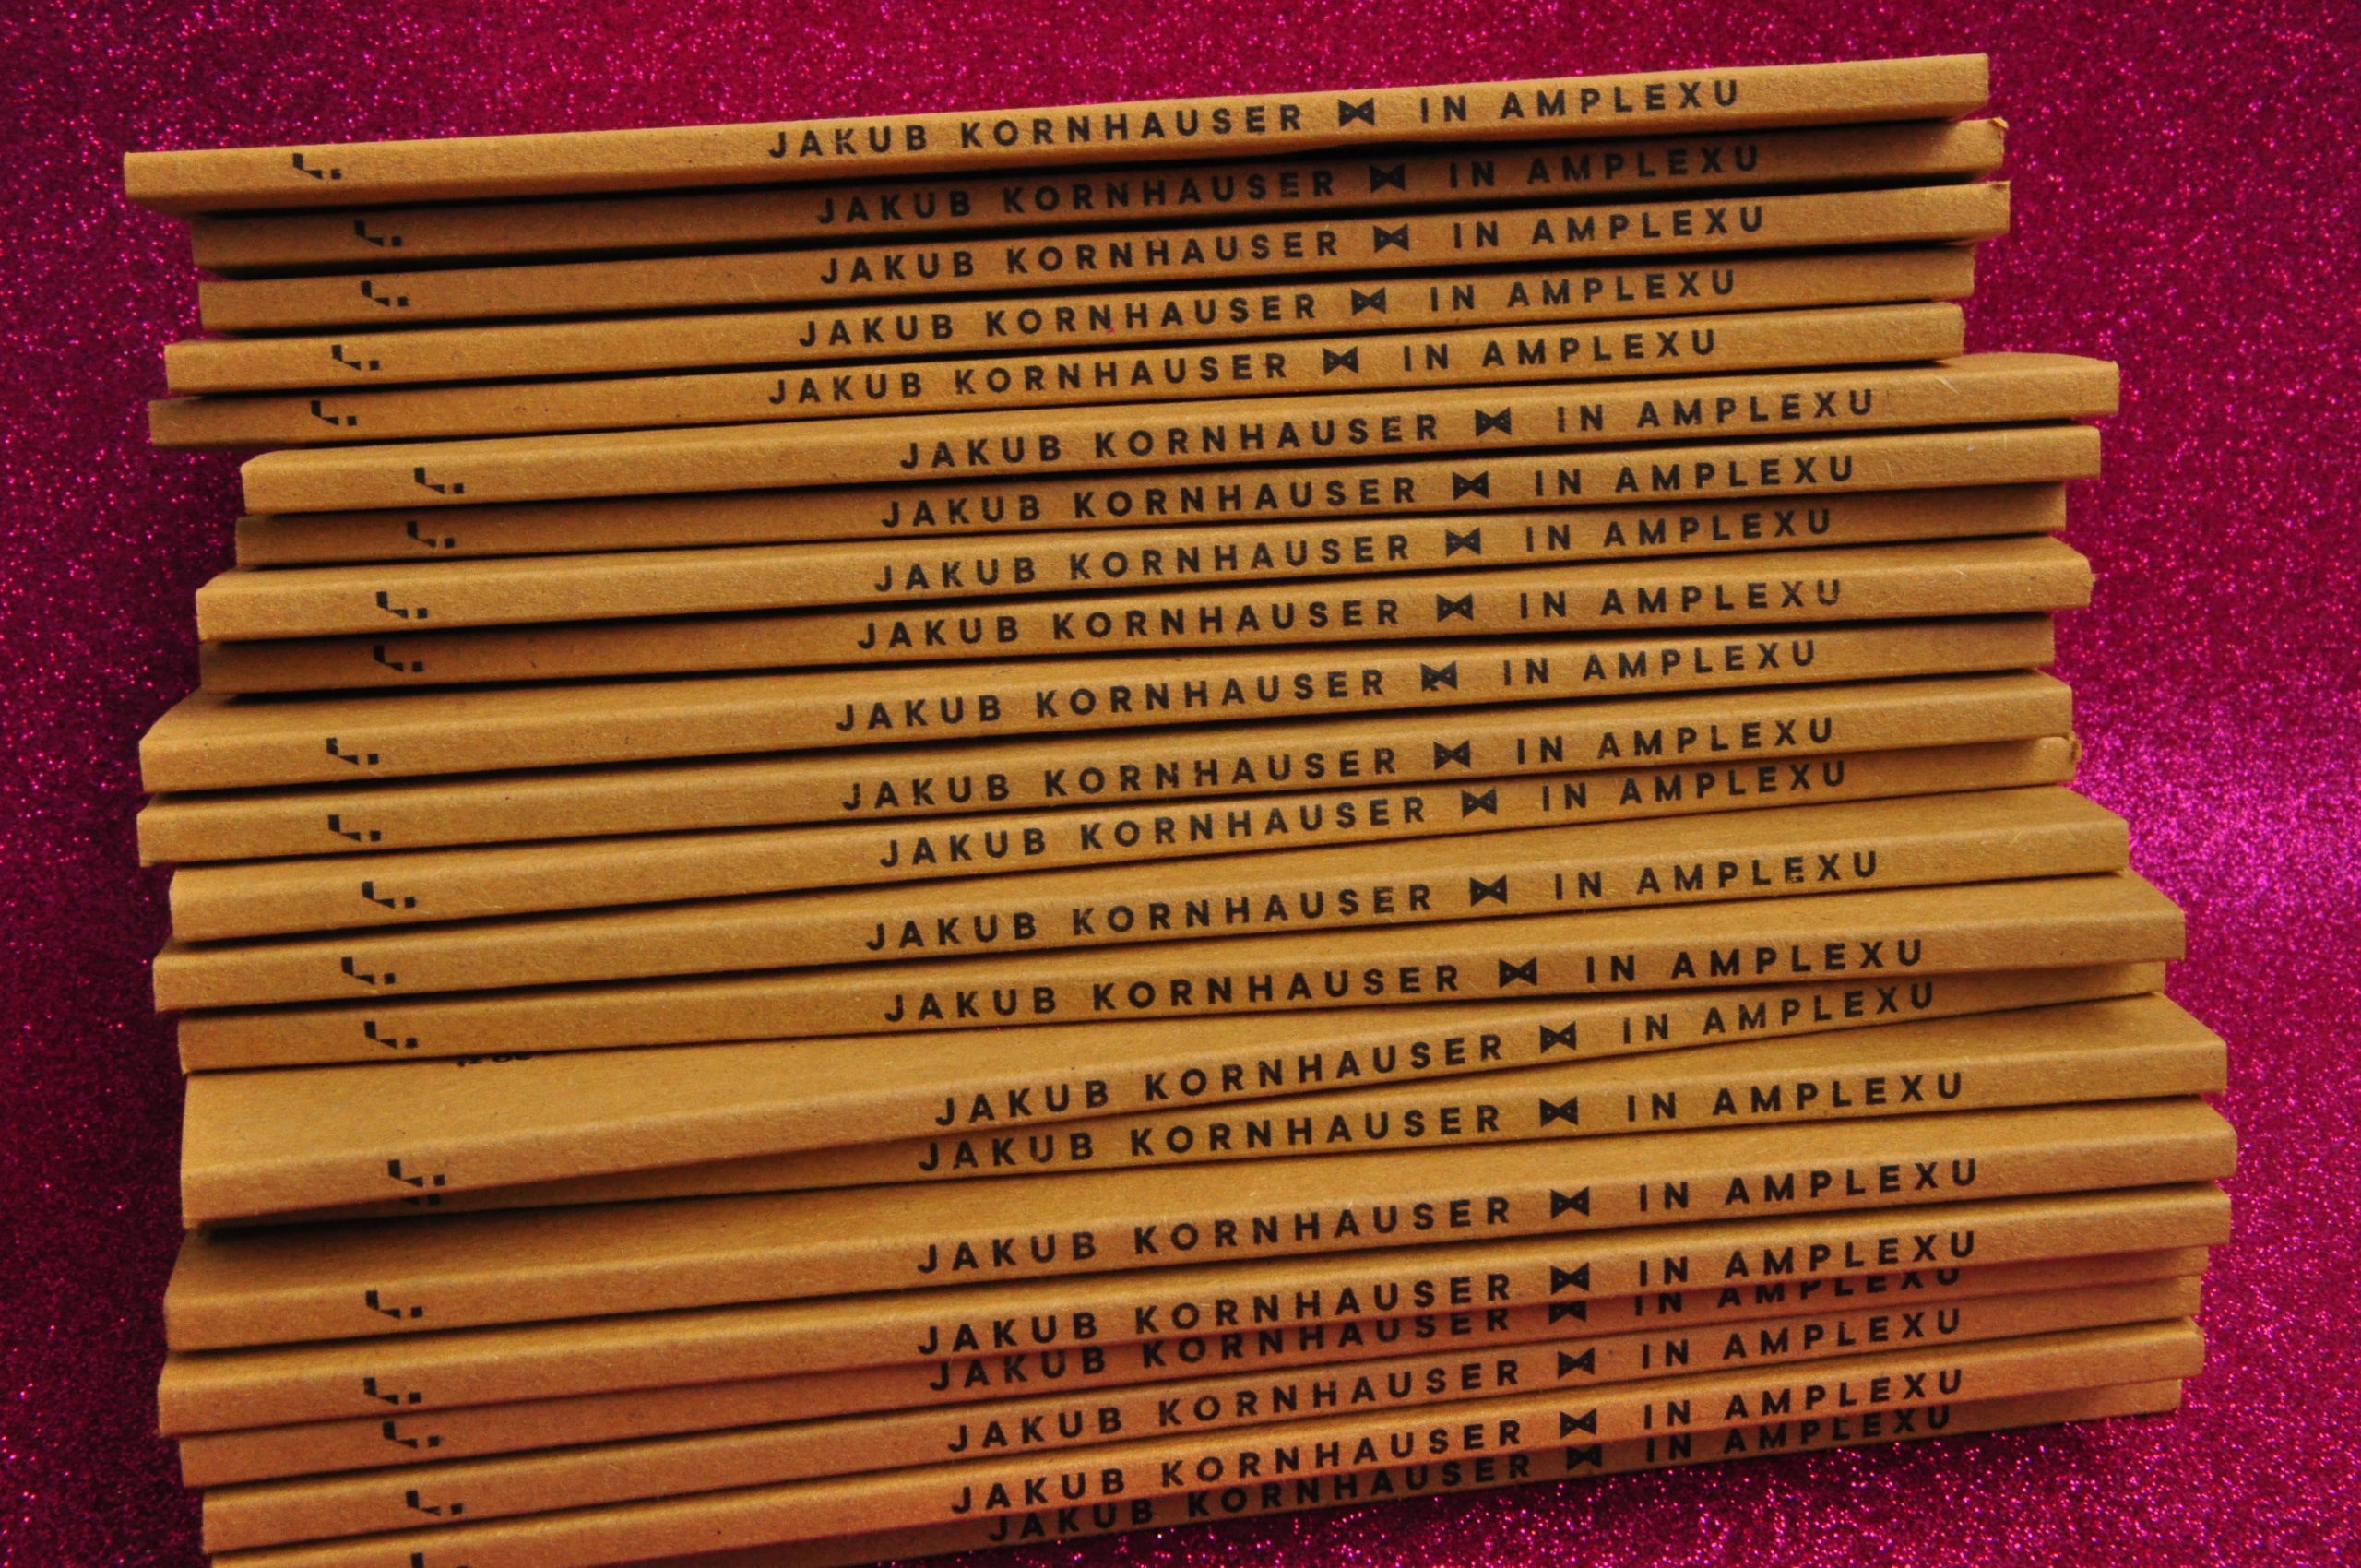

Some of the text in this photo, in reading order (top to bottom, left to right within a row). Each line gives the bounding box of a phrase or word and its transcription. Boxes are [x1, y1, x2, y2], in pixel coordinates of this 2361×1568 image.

[768, 79, 1738, 159] JAKUB KORNHAUSER IN AMPLEXU
[817, 143, 1759, 225] JAKUB KORNHAUSER IN AMPLEXU
[820, 206, 1762, 285] JAKUB KORNHAUSER IN AMPLEXU
[798, 269, 1734, 348] JAKUB KORNHAUSER IN AMPLEXU
[768, 328, 1714, 405] JAKUB KORNHAUSER IN AMPLEXU
[899, 388, 1872, 469] JAKUB KORNHAUSER IN AMPLEXU
[881, 455, 1853, 529] JAKUB KORNHAUSER IN AMPLEXU
[874, 507, 1830, 592] JAKUB KORNHAUSER IN AMPLEXU
[857, 579, 1841, 650] JAKUB KORNHAUSER IN AMPLEXU
[836, 639, 1814, 731] JAKUB KORNHAUSER IN AMPLEXU
[842, 717, 1833, 811] JAKUB KORNHAUSER IN AMPLEXU
[879, 758, 1845, 868] JAKUB KORNHAUSER IN AMPLEXU
[865, 850, 1877, 951] JAKUB KORNHAUSER IN AMPLEXU
[884, 938, 1922, 1023] JAKUB KORNHAUSER IN AMPLEXU
[935, 980, 1933, 1126] JAKUB KORNHAUSER IN AMPLEXU
[919, 1072, 1962, 1172] JAKUB KORNHAUSER IN AMPLEXU
[917, 1158, 1976, 1274] JAKUB KORNHAUSER IN AMPLEXU
[917, 1230, 1975, 1355] JAKUB KORNHAUSER IN AMPLEXU
[929, 1345, 1106, 1392] JAKUB
[1141, 1307, 1510, 1369] KORNHAUSER
[1633, 1291, 1684, 1317] IN
[947, 1307, 1960, 1453] JAKUB KORNHAUSER IN AMPLEXU
[951, 1368, 1962, 1514] JAKUB KORNHAUSER IN AMPLEXU
[988, 1403, 1952, 1542] JAKUB KORNHAUSER IN AMPLEXU
